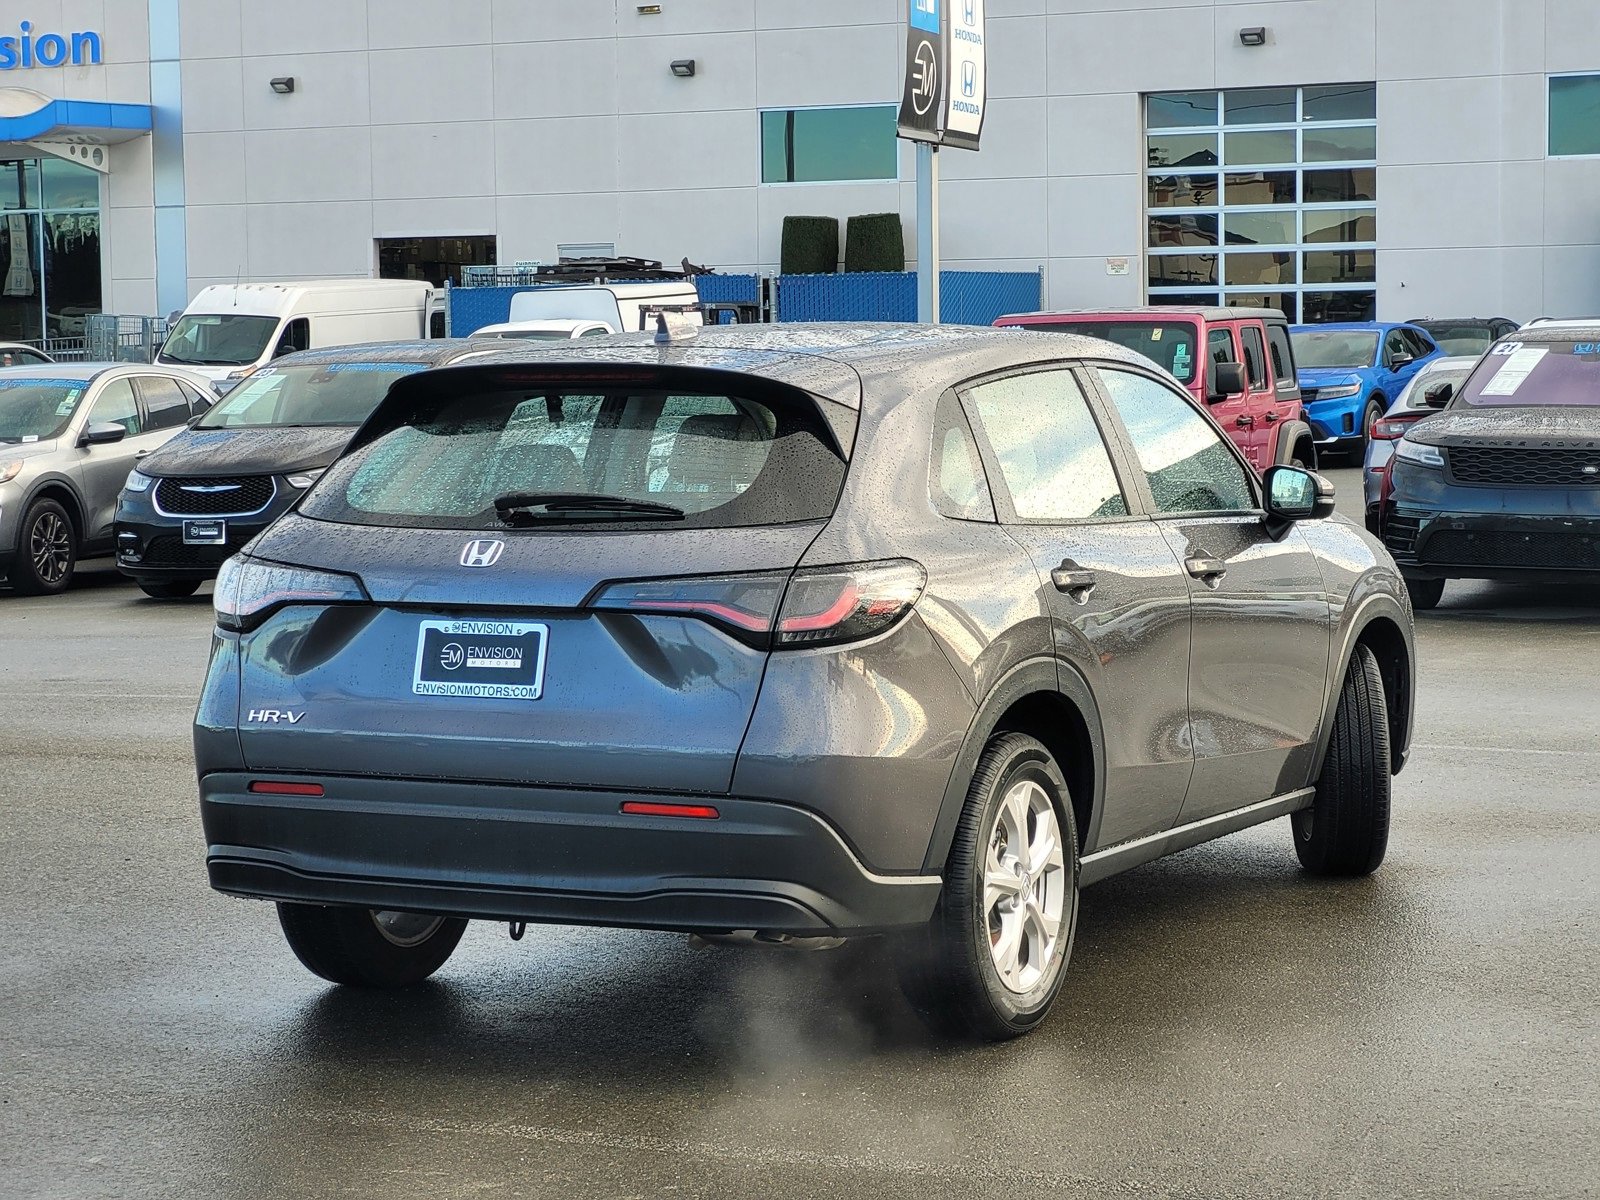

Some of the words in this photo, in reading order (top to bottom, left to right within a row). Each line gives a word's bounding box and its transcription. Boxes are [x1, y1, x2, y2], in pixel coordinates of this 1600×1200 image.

[0, 20, 101, 70] sion
[954, 29, 983, 46] HONDA
[952, 100, 981, 116] HONDA
[1462, 439, 1527, 447] RANGE
[460, 622, 514, 635] ENVISION
[467, 646, 523, 659] ENVISION
[470, 659, 517, 667] MOTORS
[415, 683, 537, 698] ENVISIONMOTORS.COM
[248, 709, 306, 724] HR-V
